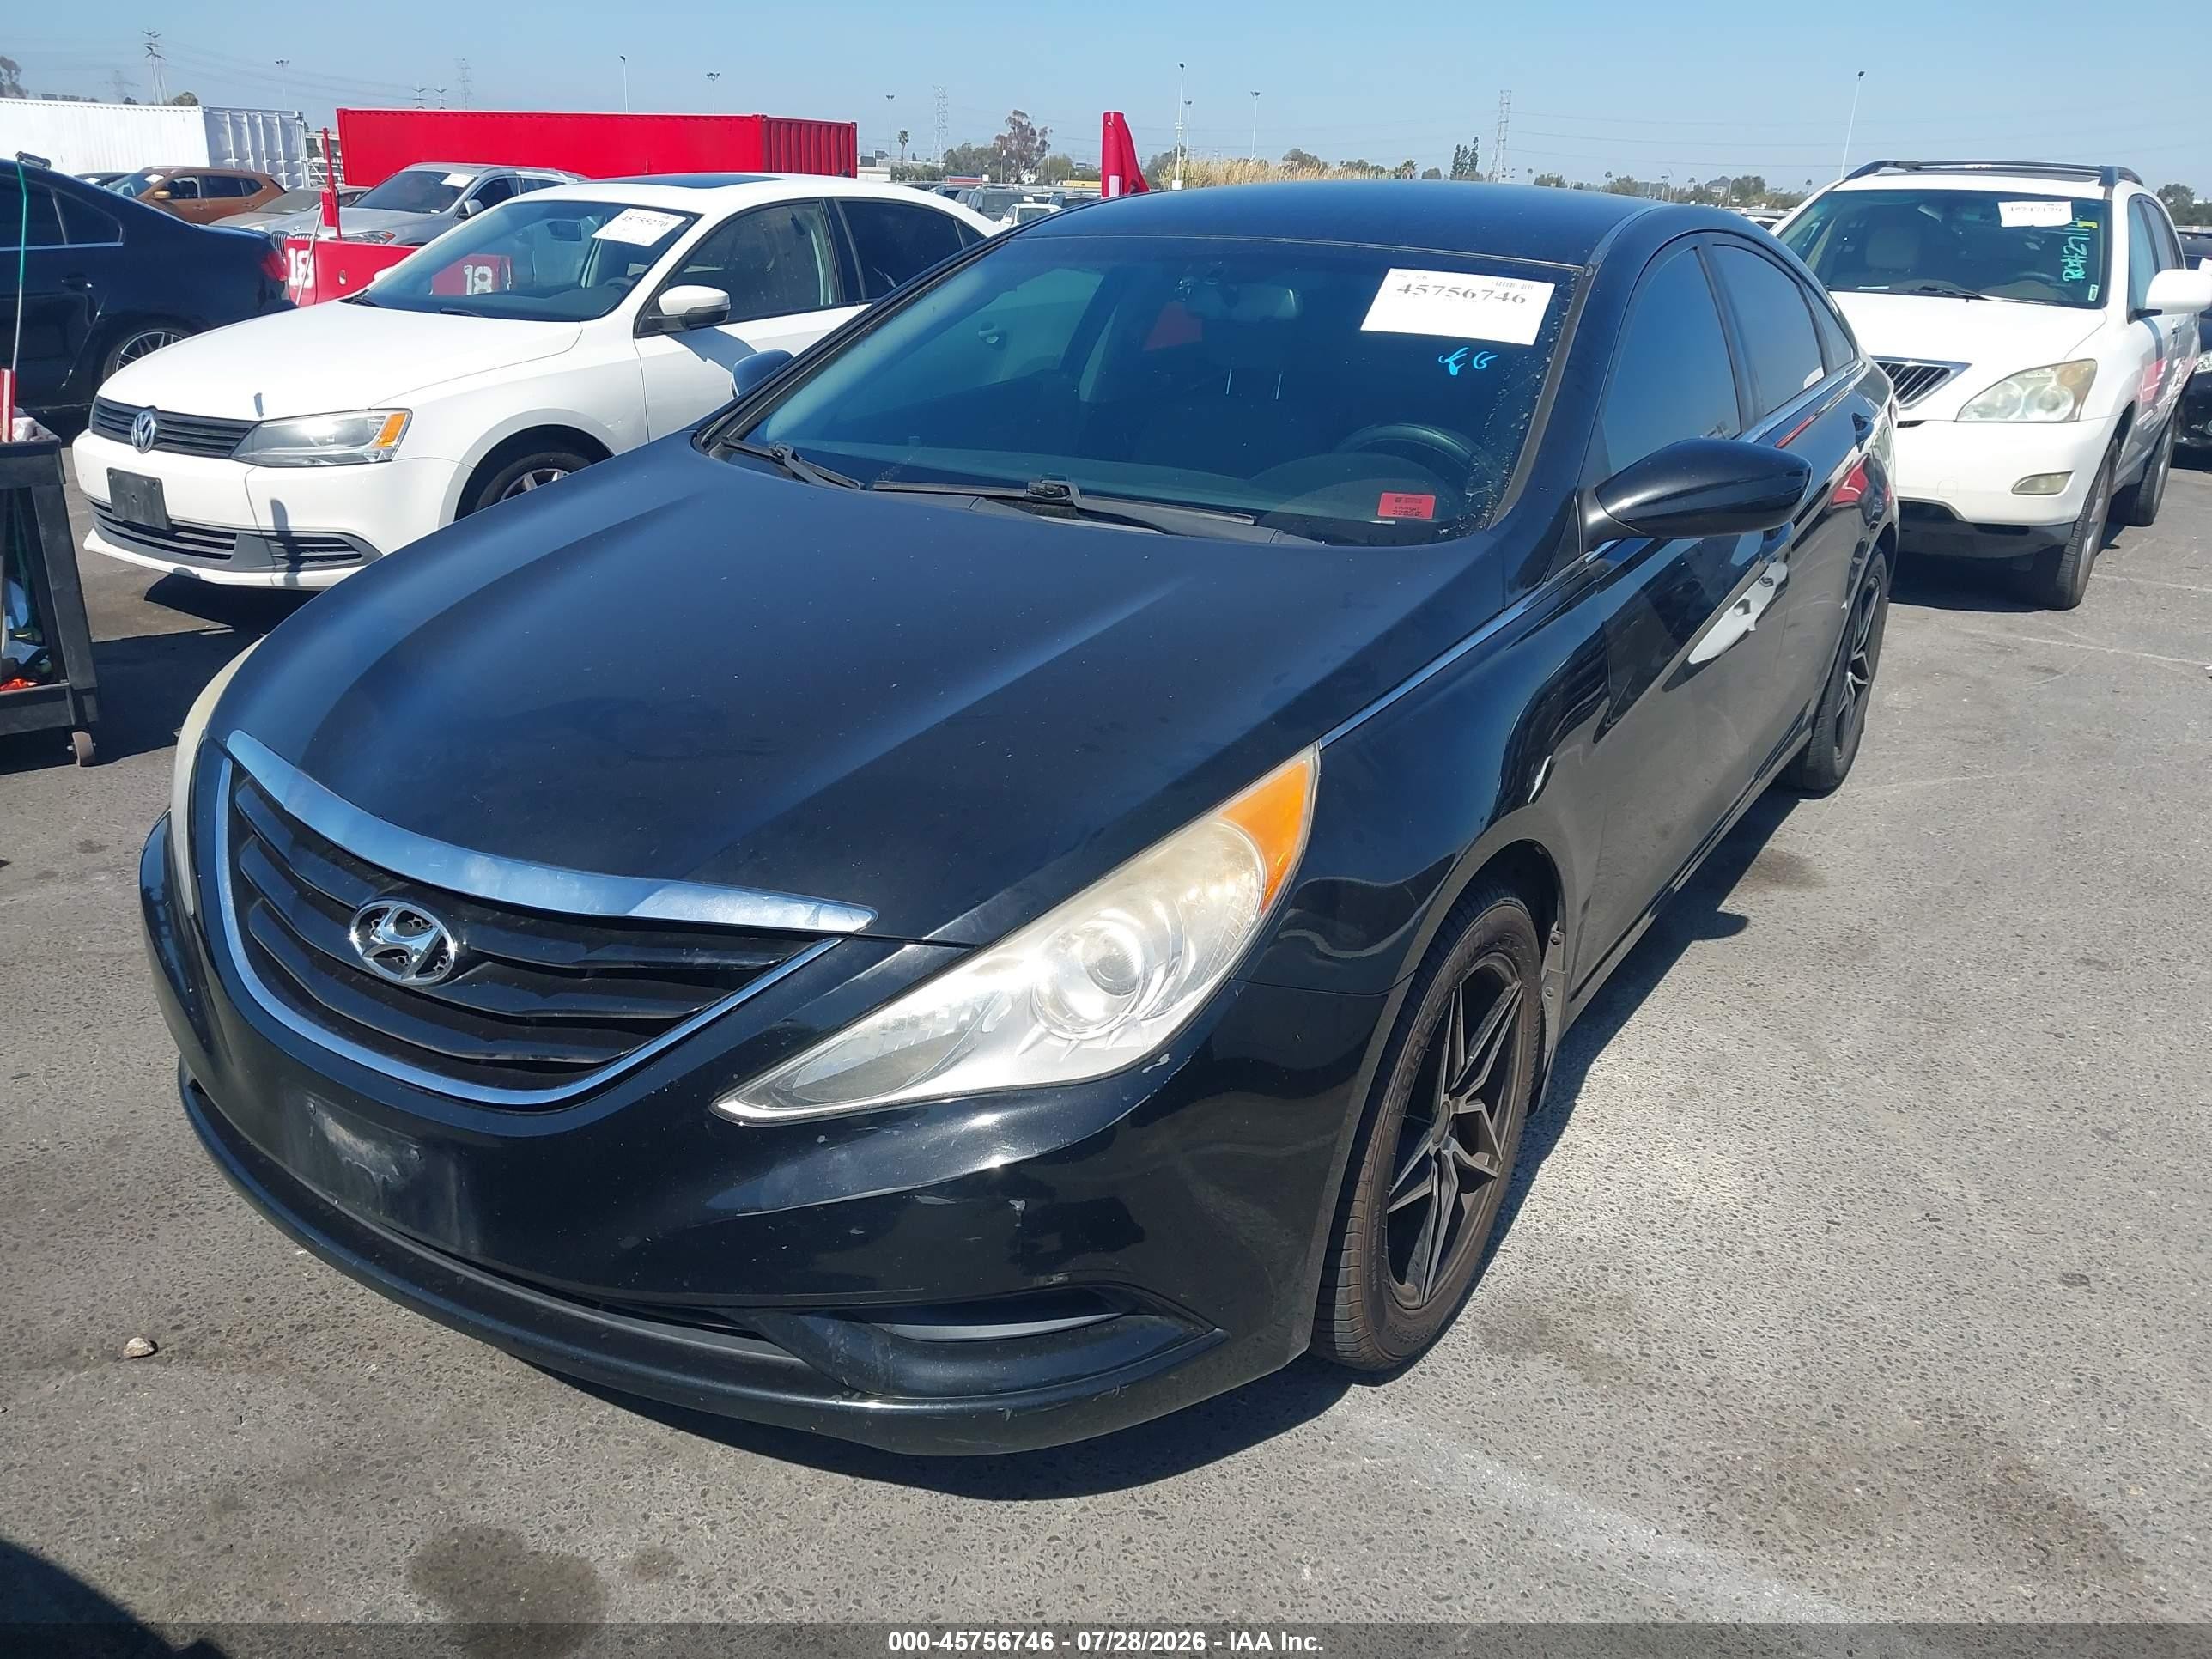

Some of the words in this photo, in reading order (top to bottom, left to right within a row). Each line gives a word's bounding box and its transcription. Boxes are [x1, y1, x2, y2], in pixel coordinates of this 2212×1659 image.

[288, 247, 315, 289] 18
[464, 264, 493, 295] 18
[1396, 283, 1527, 304] 45756746
